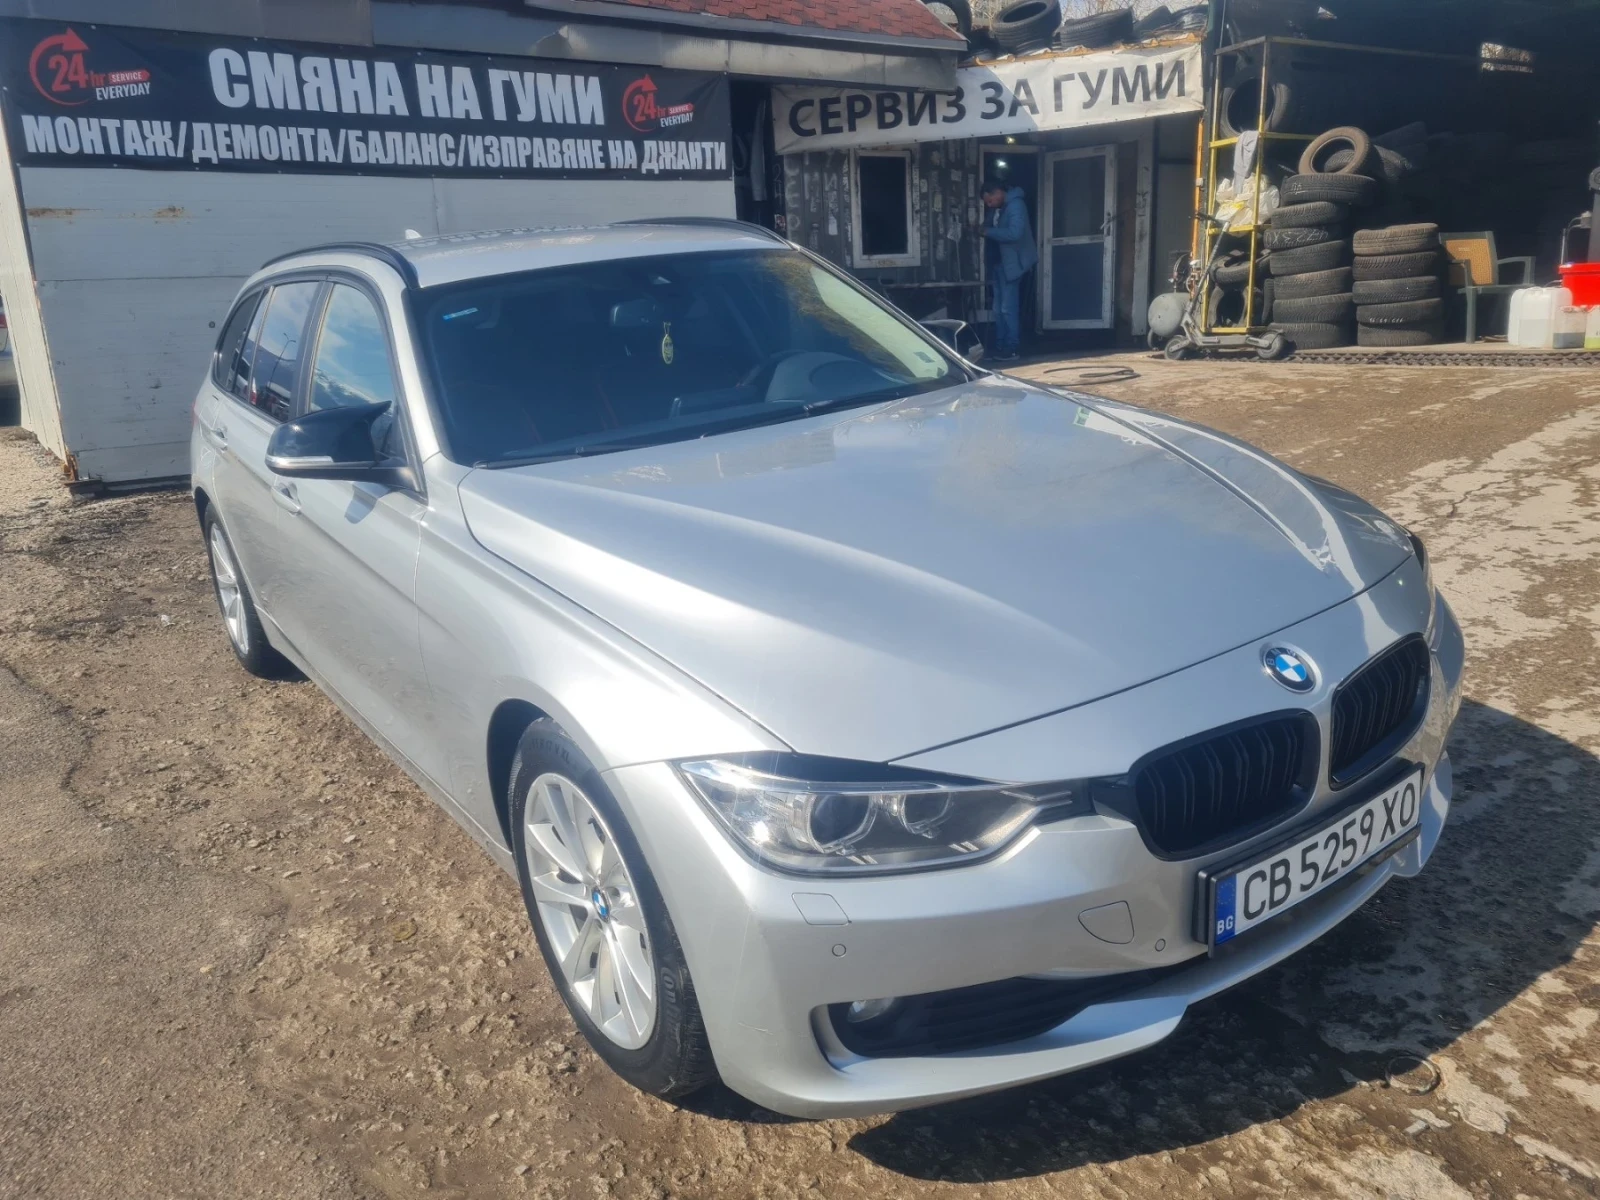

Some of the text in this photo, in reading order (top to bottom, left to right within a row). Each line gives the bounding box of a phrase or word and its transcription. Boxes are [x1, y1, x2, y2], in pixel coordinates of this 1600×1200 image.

[111, 71, 142, 82] SERVICE
[208, 48, 605, 126] СМЯНА НА ГУМИ
[95, 82, 151, 101] EVERYDAY
[789, 60, 1186, 137] СЕРВИЗ ЗА ГУМИ
[660, 112, 694, 128] EVERYDAY
[669, 105, 689, 115] SERVICE
[607, 139, 637, 170] НА
[641, 140, 727, 175] ДЖАНТИ
[1300, 808, 1375, 892] 5259
[1217, 915, 1234, 936] BG
